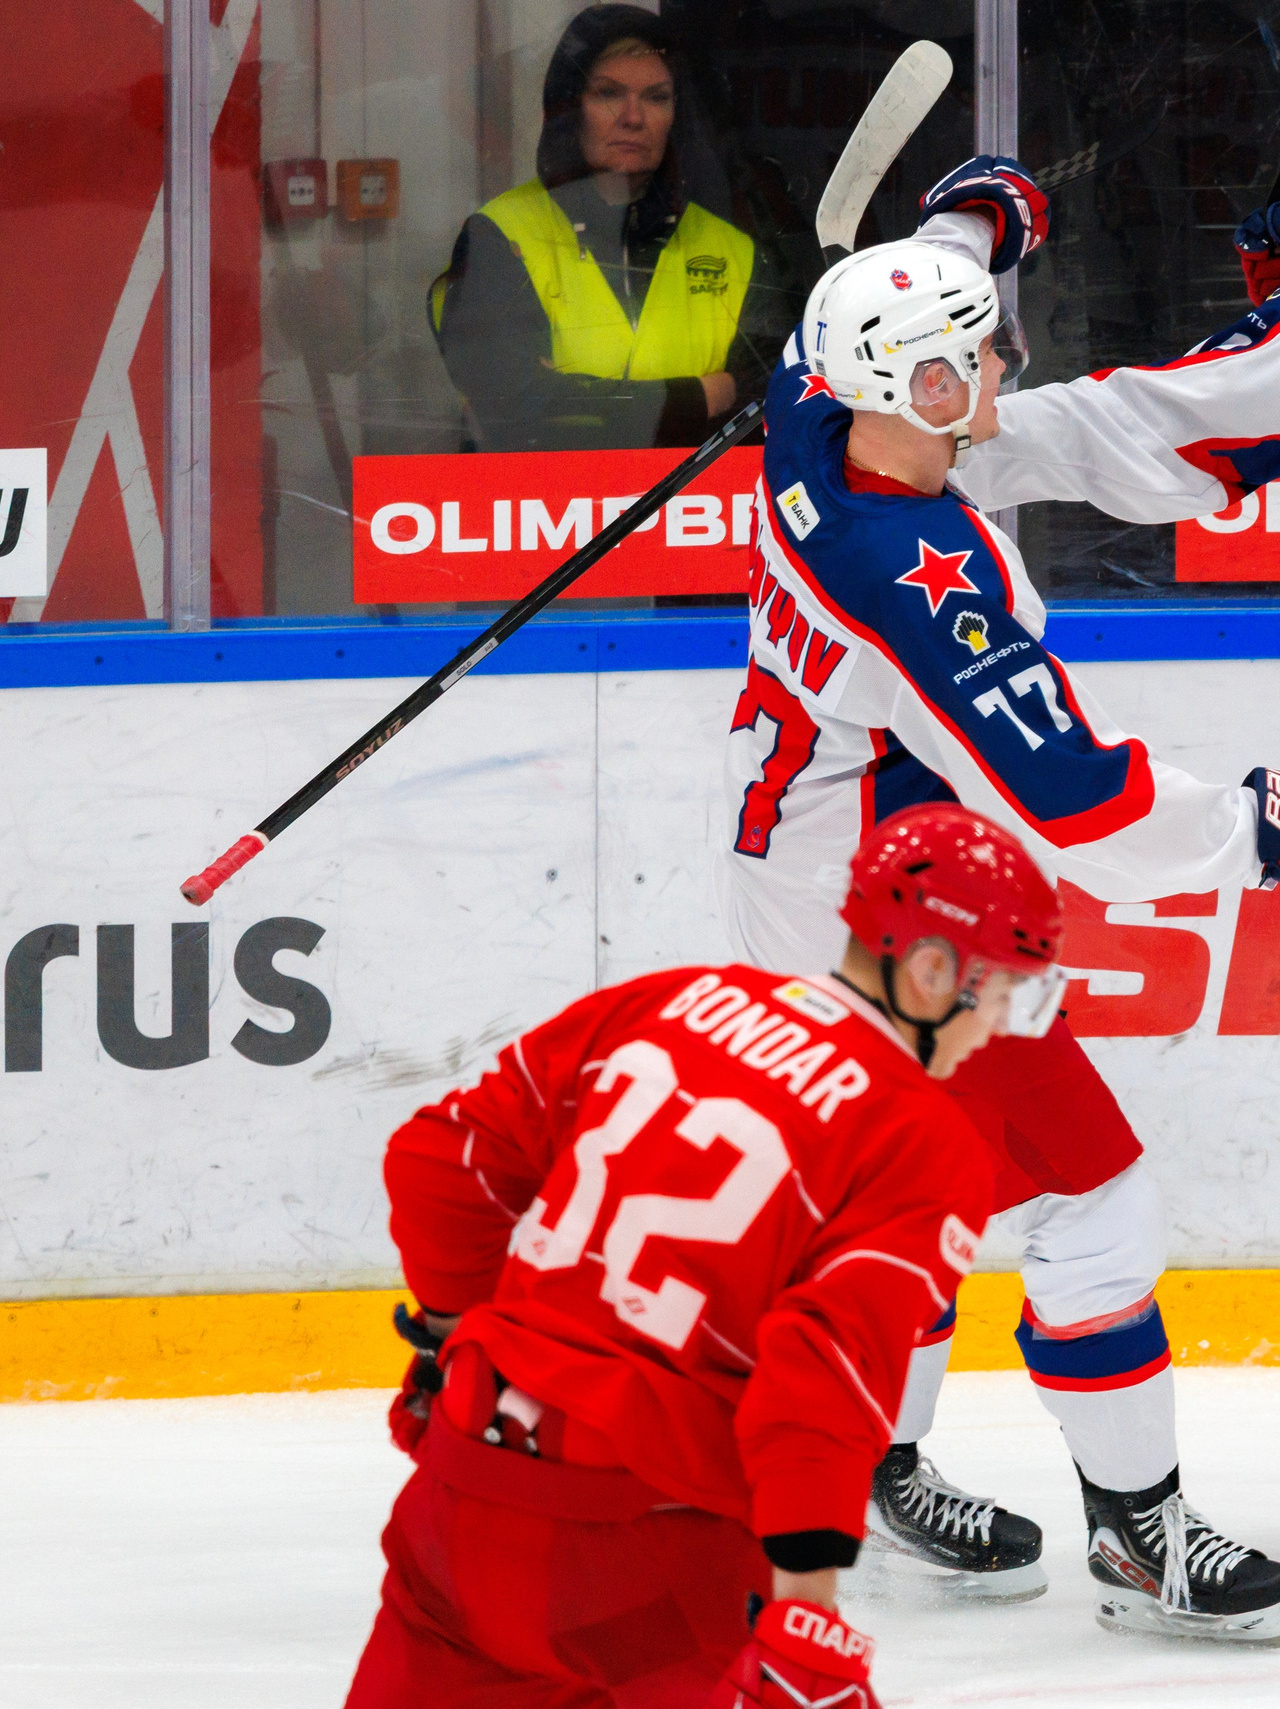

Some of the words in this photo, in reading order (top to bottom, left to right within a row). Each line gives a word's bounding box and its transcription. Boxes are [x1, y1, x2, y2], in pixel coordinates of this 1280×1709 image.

[903, 328, 945, 346] РОСНЕФТЬ
[953, 641, 1031, 685] РОСНЕФТЬ
[972, 662, 1074, 752] 77
[335, 717, 404, 780] SOYUZ
[659, 974, 870, 1123] BONDAR
[513, 1039, 794, 1350] 32
[783, 1604, 877, 1667] СПАРТ
